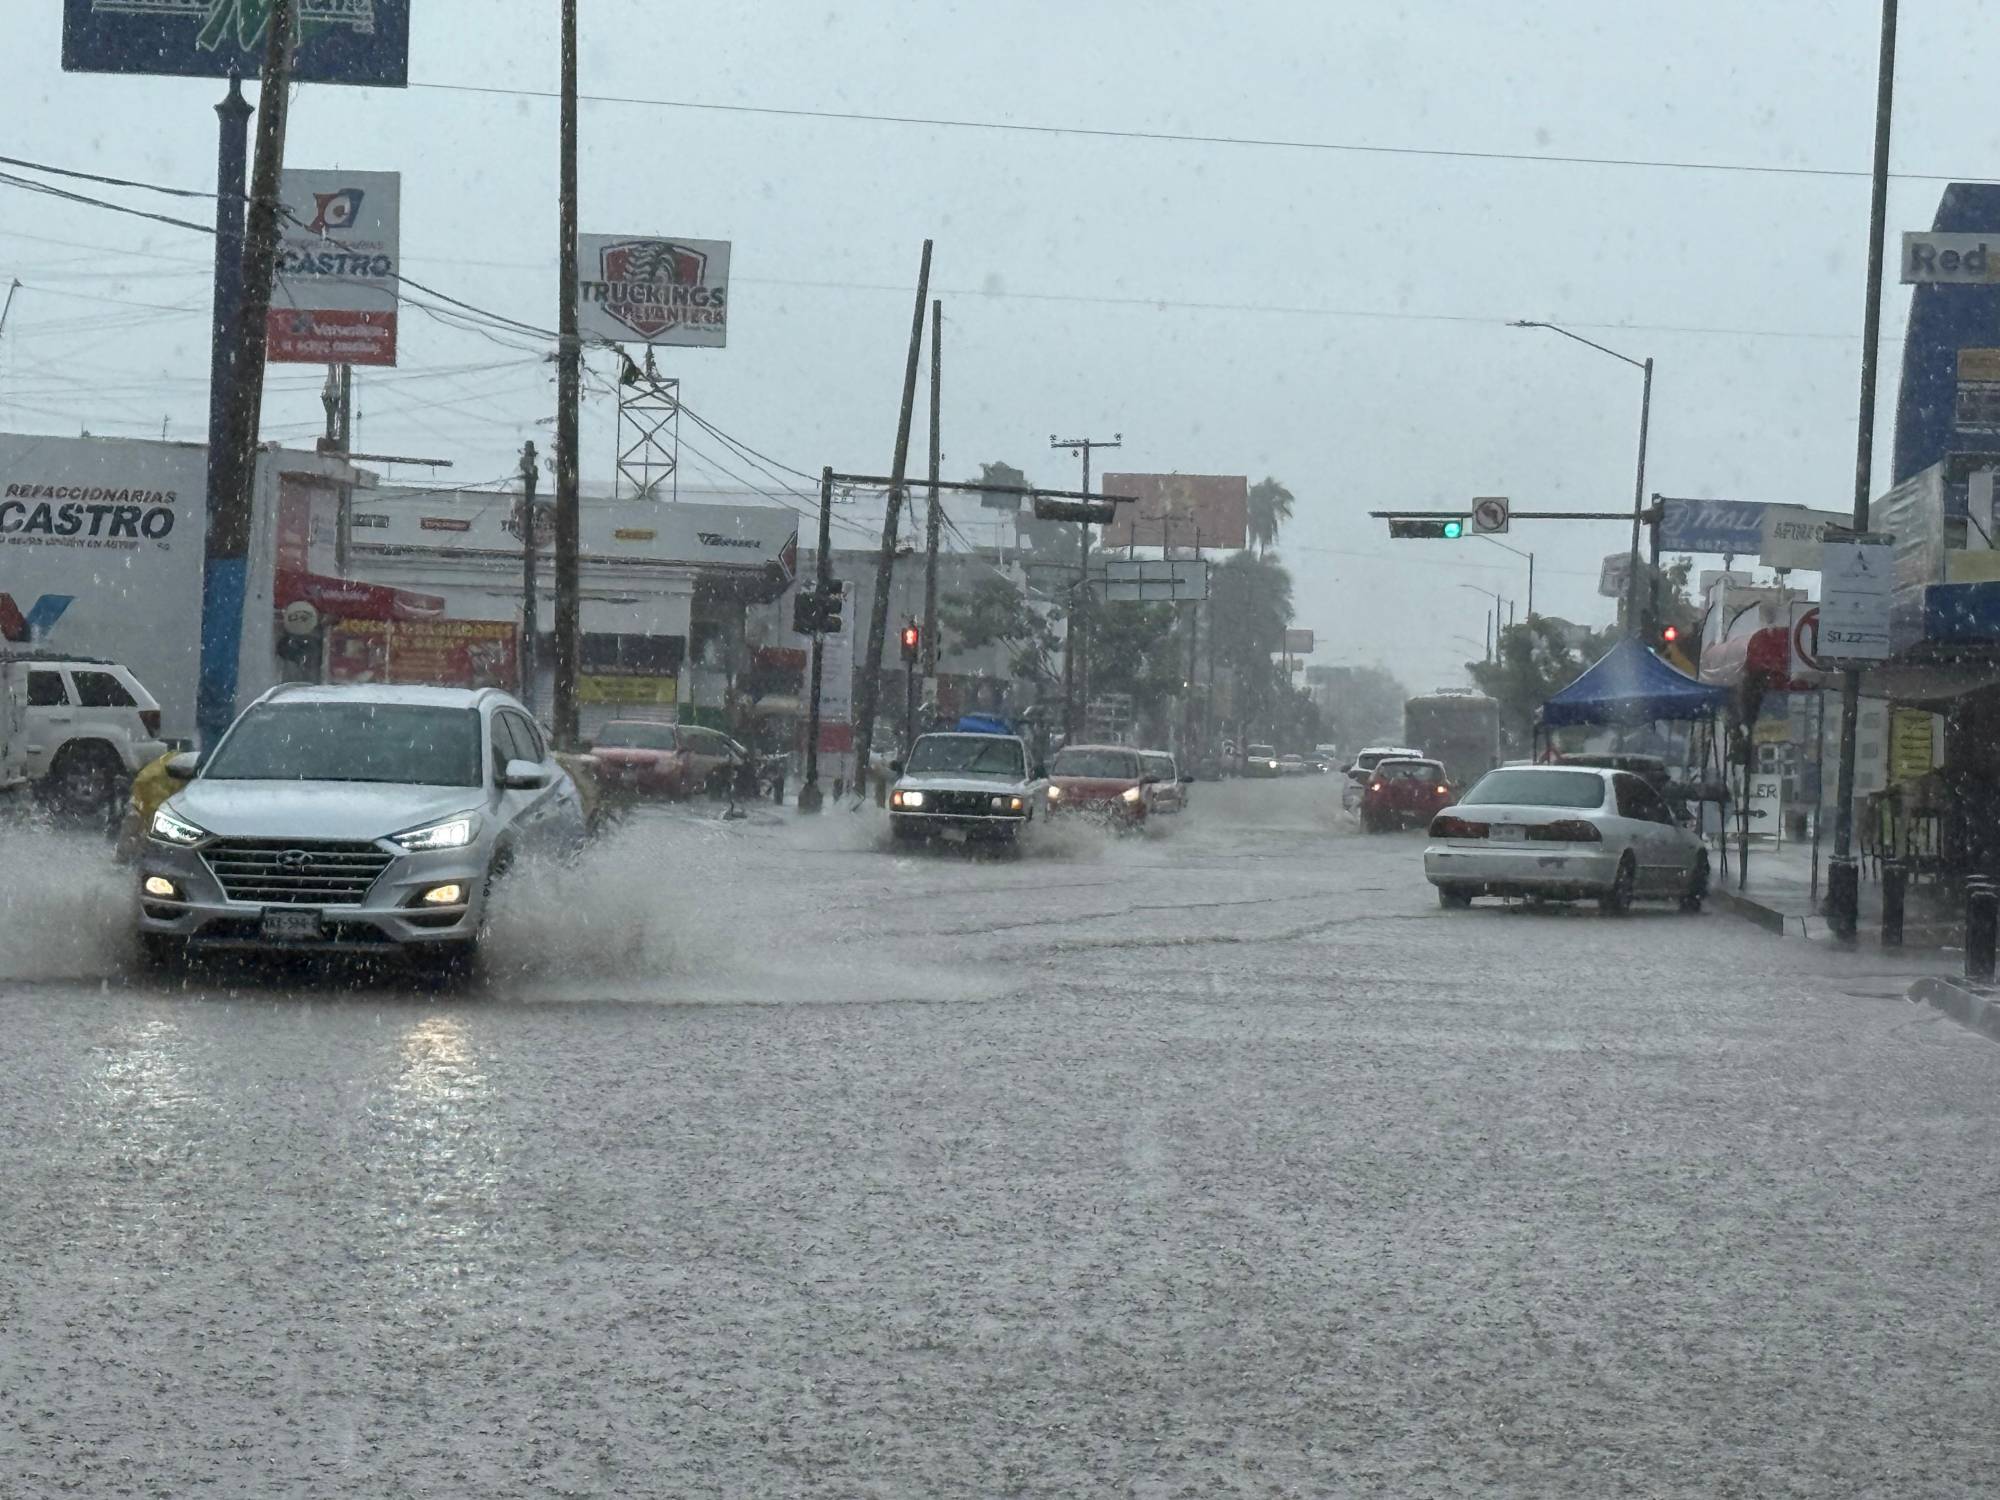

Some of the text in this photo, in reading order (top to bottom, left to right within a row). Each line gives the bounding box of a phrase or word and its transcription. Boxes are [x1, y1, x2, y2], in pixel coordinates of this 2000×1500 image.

[277, 252, 392, 277] CASTRO
[1911, 242, 1986, 274] Red
[579, 281, 724, 307] TRUCKINGS
[5, 483, 178, 504] REFACCIONARIAS
[0, 500, 175, 539] CASTRO
